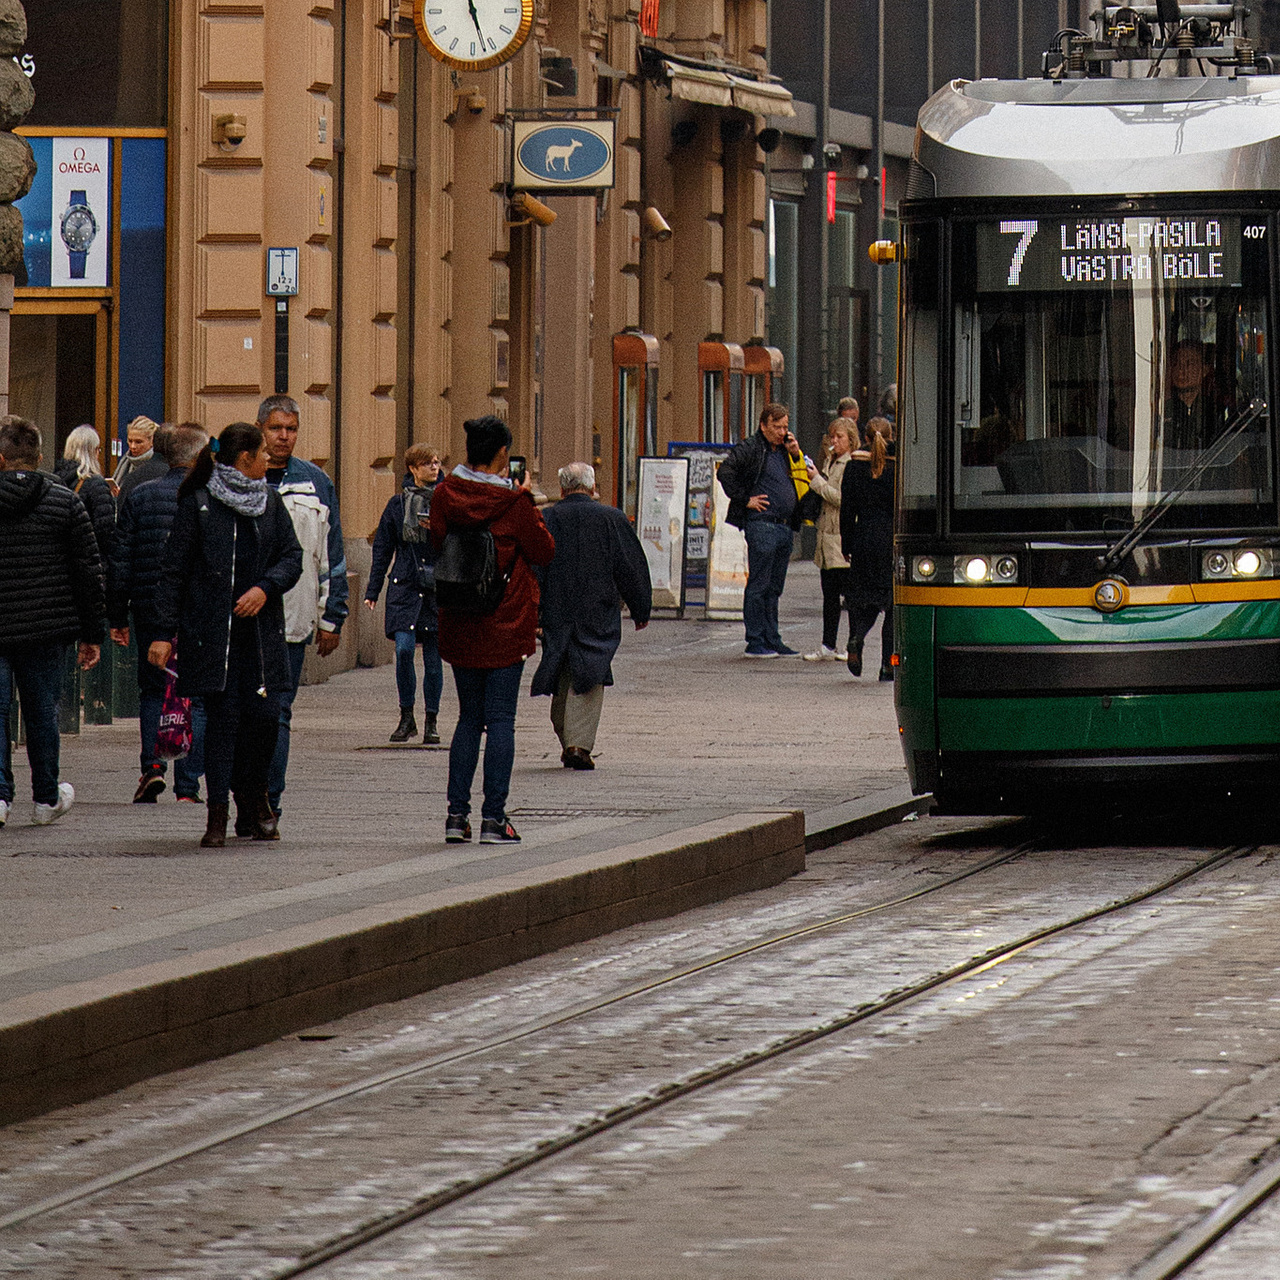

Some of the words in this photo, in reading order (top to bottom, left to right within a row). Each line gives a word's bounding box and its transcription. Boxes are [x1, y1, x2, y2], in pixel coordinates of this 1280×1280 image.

[58, 162, 101, 174] OMEGA
[1000, 220, 1038, 286] 7
[1060, 220, 1222, 250] LÄNSI-PASILA
[1243, 225, 1267, 239] 407
[1060, 254, 1152, 282] VÄSTRA
[1162, 252, 1224, 279] BÖLE
